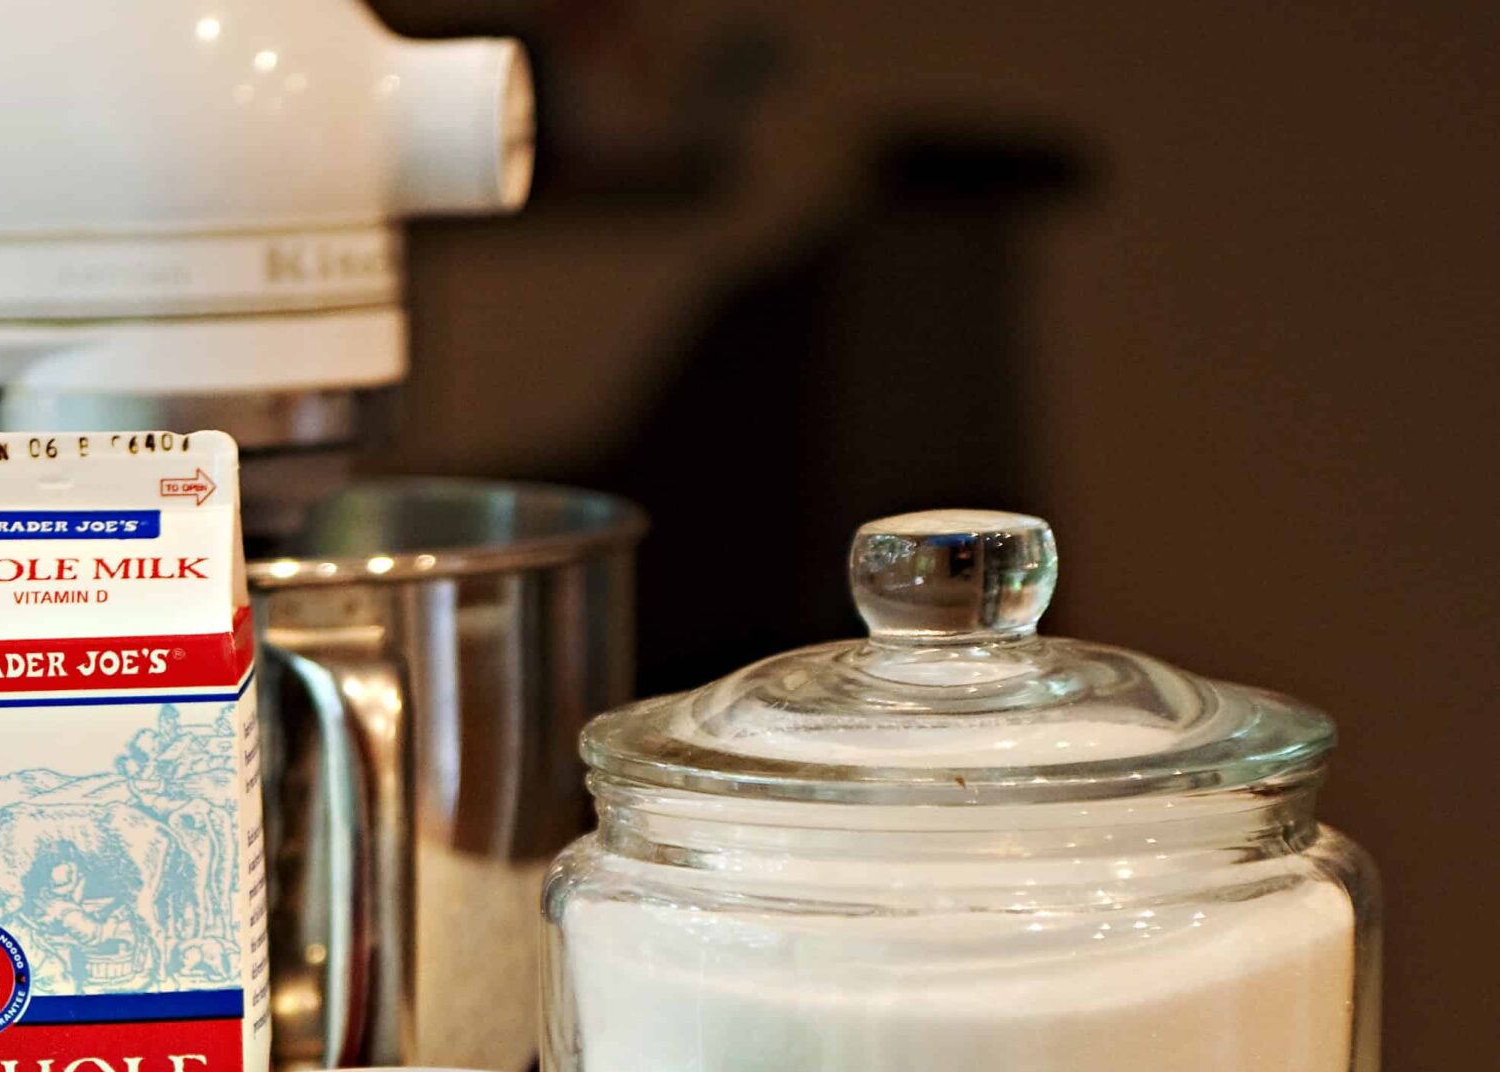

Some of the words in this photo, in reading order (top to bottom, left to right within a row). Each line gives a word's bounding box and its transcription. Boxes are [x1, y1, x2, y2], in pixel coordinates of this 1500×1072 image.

[165, 483, 179, 492] TO
[182, 482, 208, 492] OPEN
[75, 519, 139, 533] JOE'S
[92, 556, 210, 580] MILK
[13, 591, 89, 605] VITAMIN
[97, 589, 109, 603] D
[75, 648, 171, 676] JOE'S
